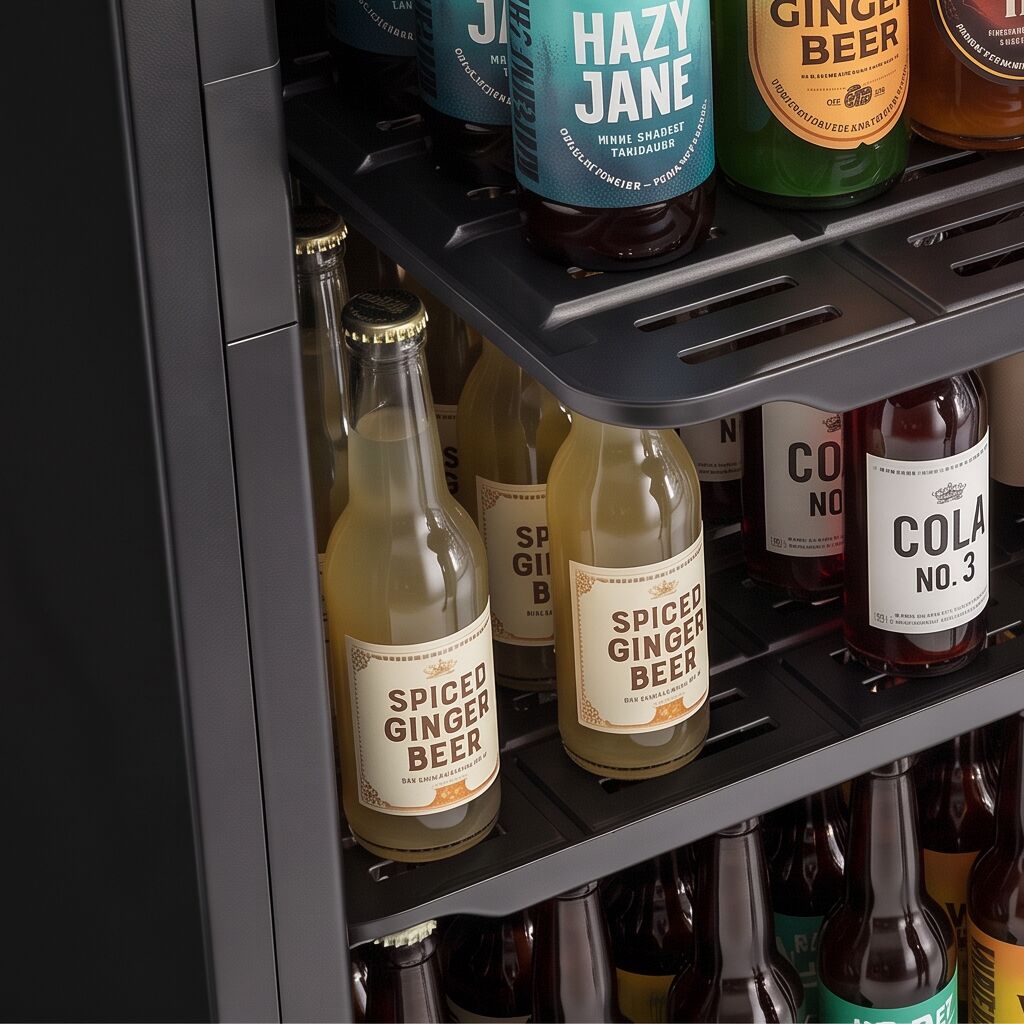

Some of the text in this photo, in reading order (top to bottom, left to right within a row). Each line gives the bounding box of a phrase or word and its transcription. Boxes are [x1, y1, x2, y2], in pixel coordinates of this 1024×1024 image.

[800, 17, 899, 66] BEER
[574, 53, 694, 125] JANE
[893, 493, 986, 558] COLA
[915, 551, 976, 594] NO. 3
[611, 583, 701, 634] SPICED
[607, 608, 704, 662] GINGER
[388, 662, 486, 712] SPICED
[630, 646, 697, 691] BEER
[384, 688, 490, 743] GINGER
[407, 727, 482, 772] BEER
